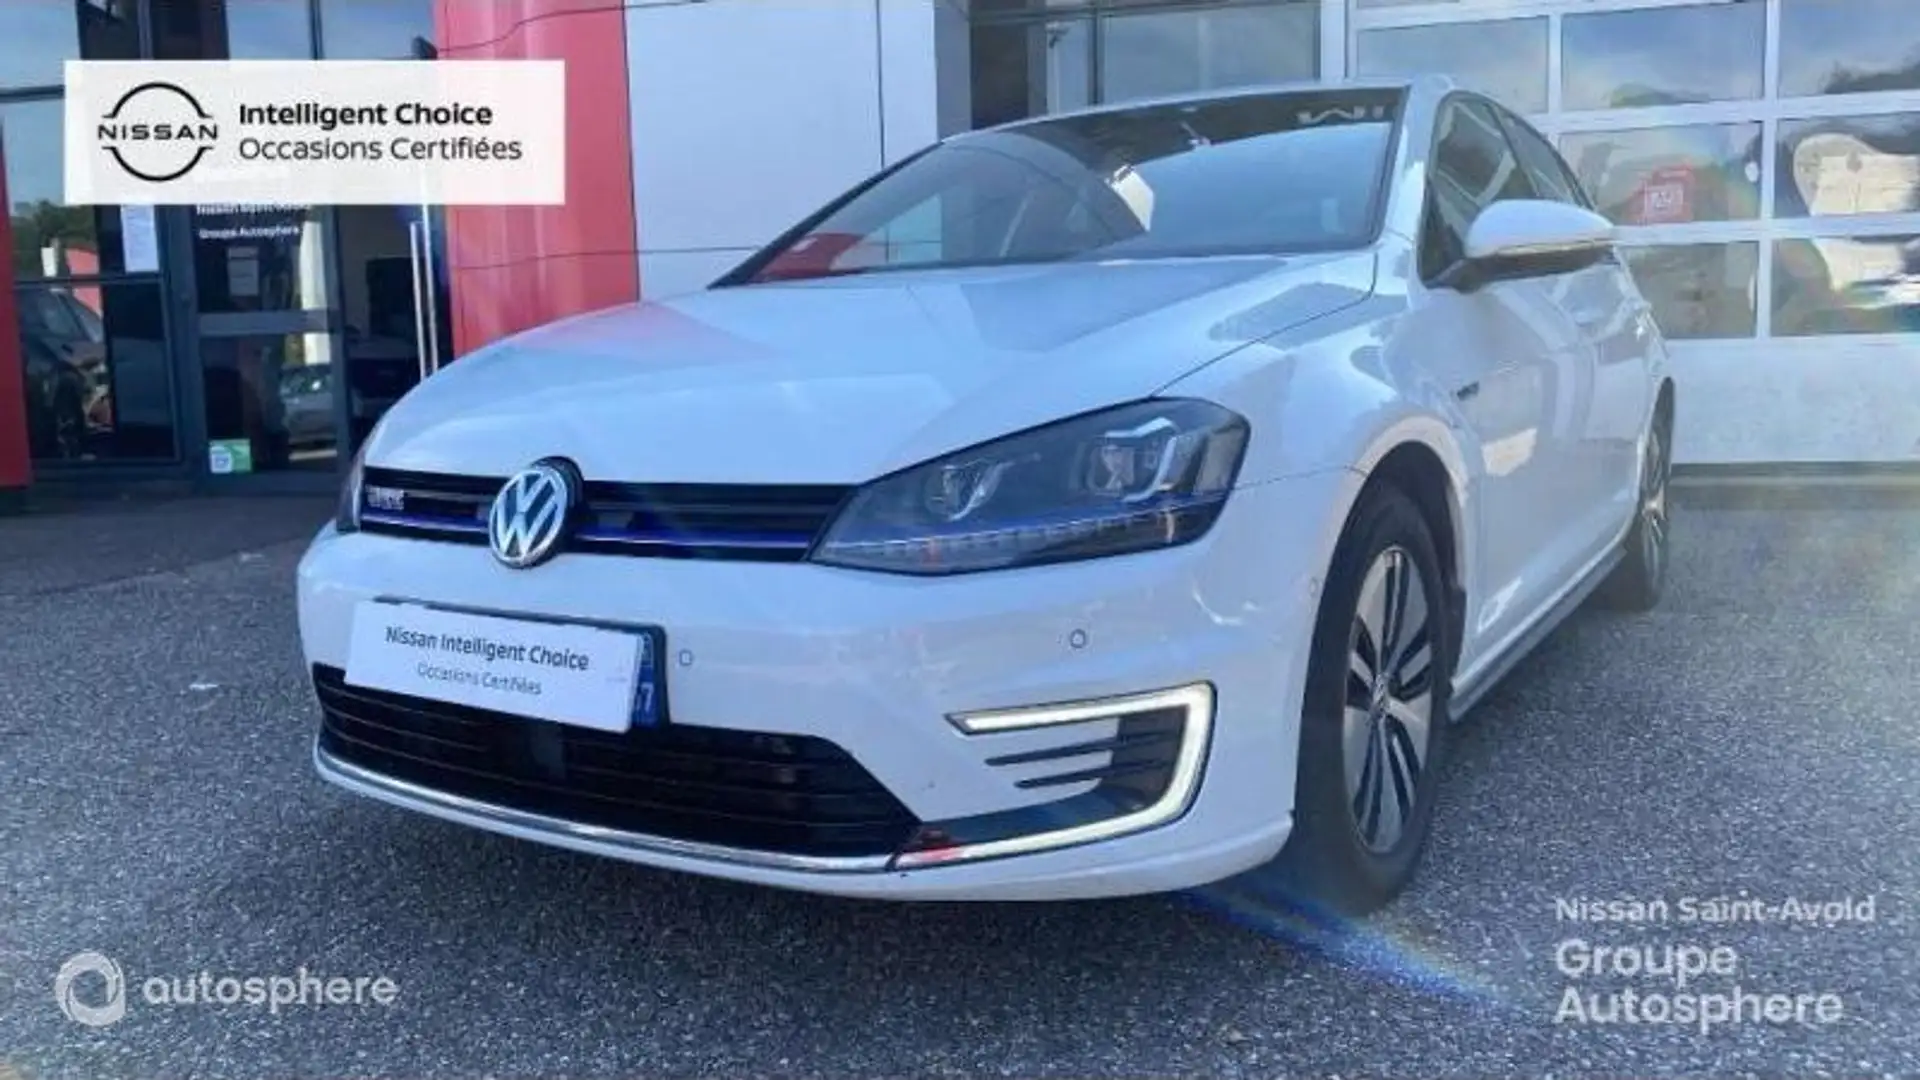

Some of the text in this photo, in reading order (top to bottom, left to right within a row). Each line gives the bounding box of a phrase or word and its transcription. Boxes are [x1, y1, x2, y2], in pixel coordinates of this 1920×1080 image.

[386, 626, 590, 671] Nissan Intelligent Choice
[416, 662, 480, 686] Occasions
